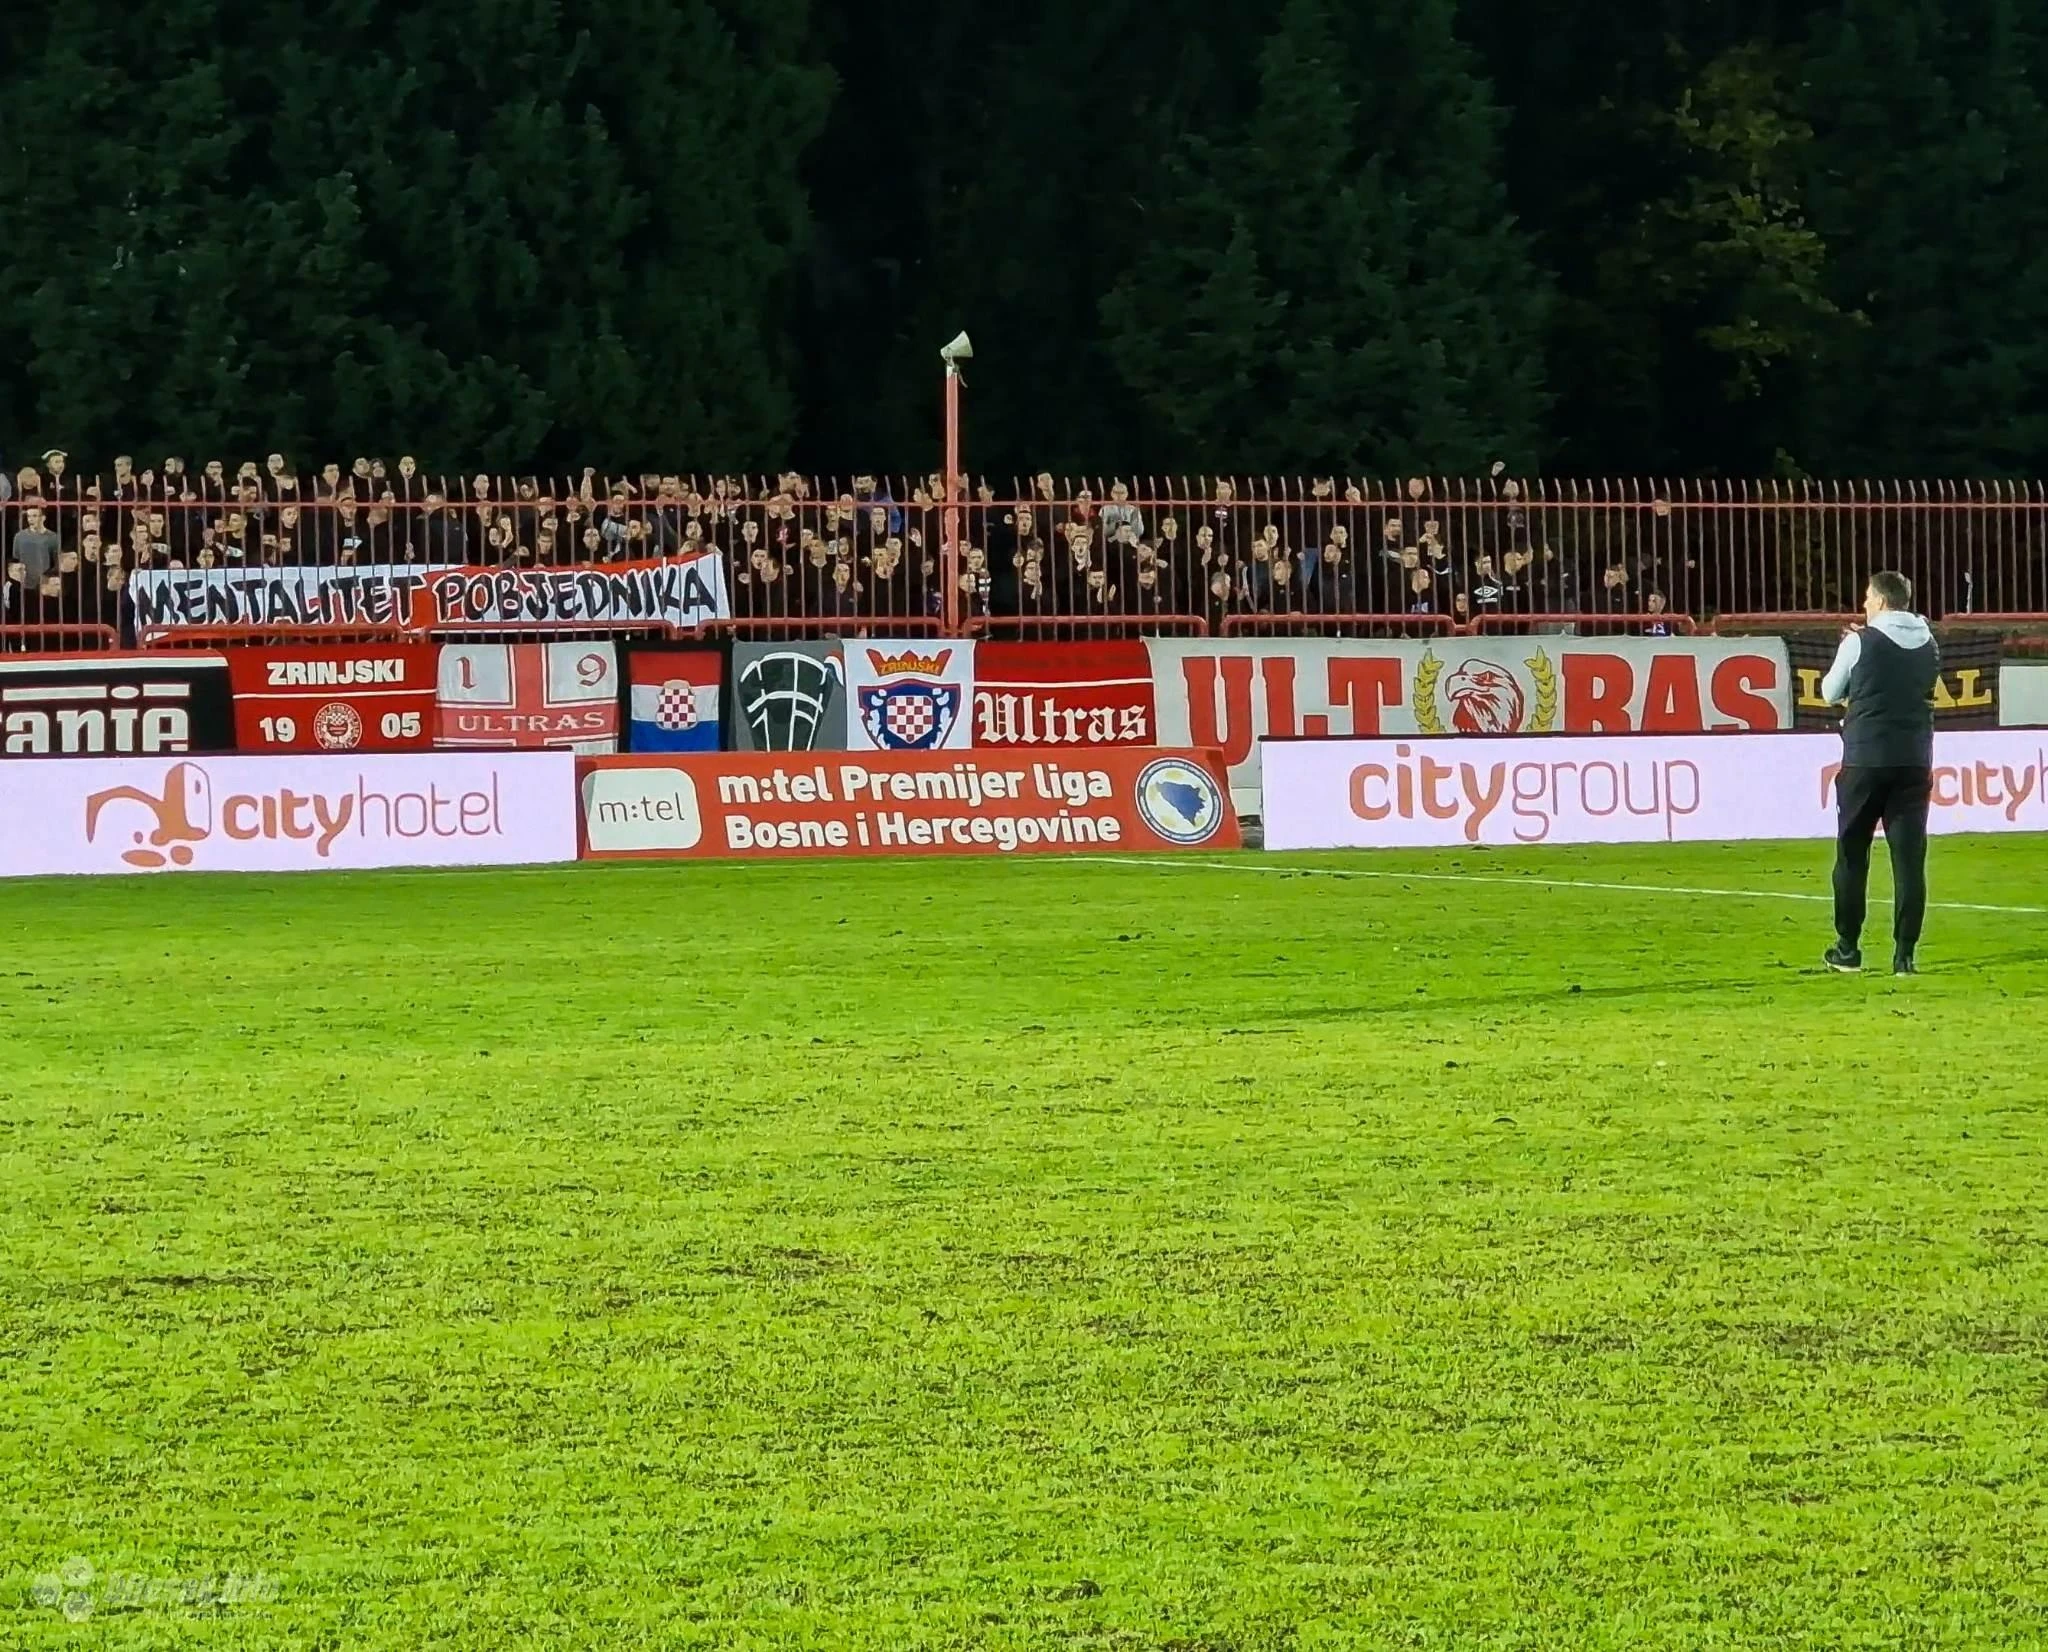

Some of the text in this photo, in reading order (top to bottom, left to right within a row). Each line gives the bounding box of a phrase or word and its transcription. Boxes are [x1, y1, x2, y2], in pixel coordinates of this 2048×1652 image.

[137, 565, 718, 625] MENTALITET POBJEDNIKA
[266, 658, 405, 685] ZRINJSKI
[576, 653, 608, 686] 9
[259, 716, 296, 742] 19
[380, 711, 421, 738] 05
[458, 711, 605, 732] ULTRAS
[974, 691, 1147, 744] Ultras
[718, 766, 833, 803] m:tel
[840, 763, 1026, 807] Premijer
[1032, 763, 1113, 806] liga
[1349, 744, 1700, 842] citygroup
[223, 772, 503, 857] cityhotel
[599, 792, 685, 823] m:tel
[724, 808, 1121, 851] Bosne i Hercegovine
